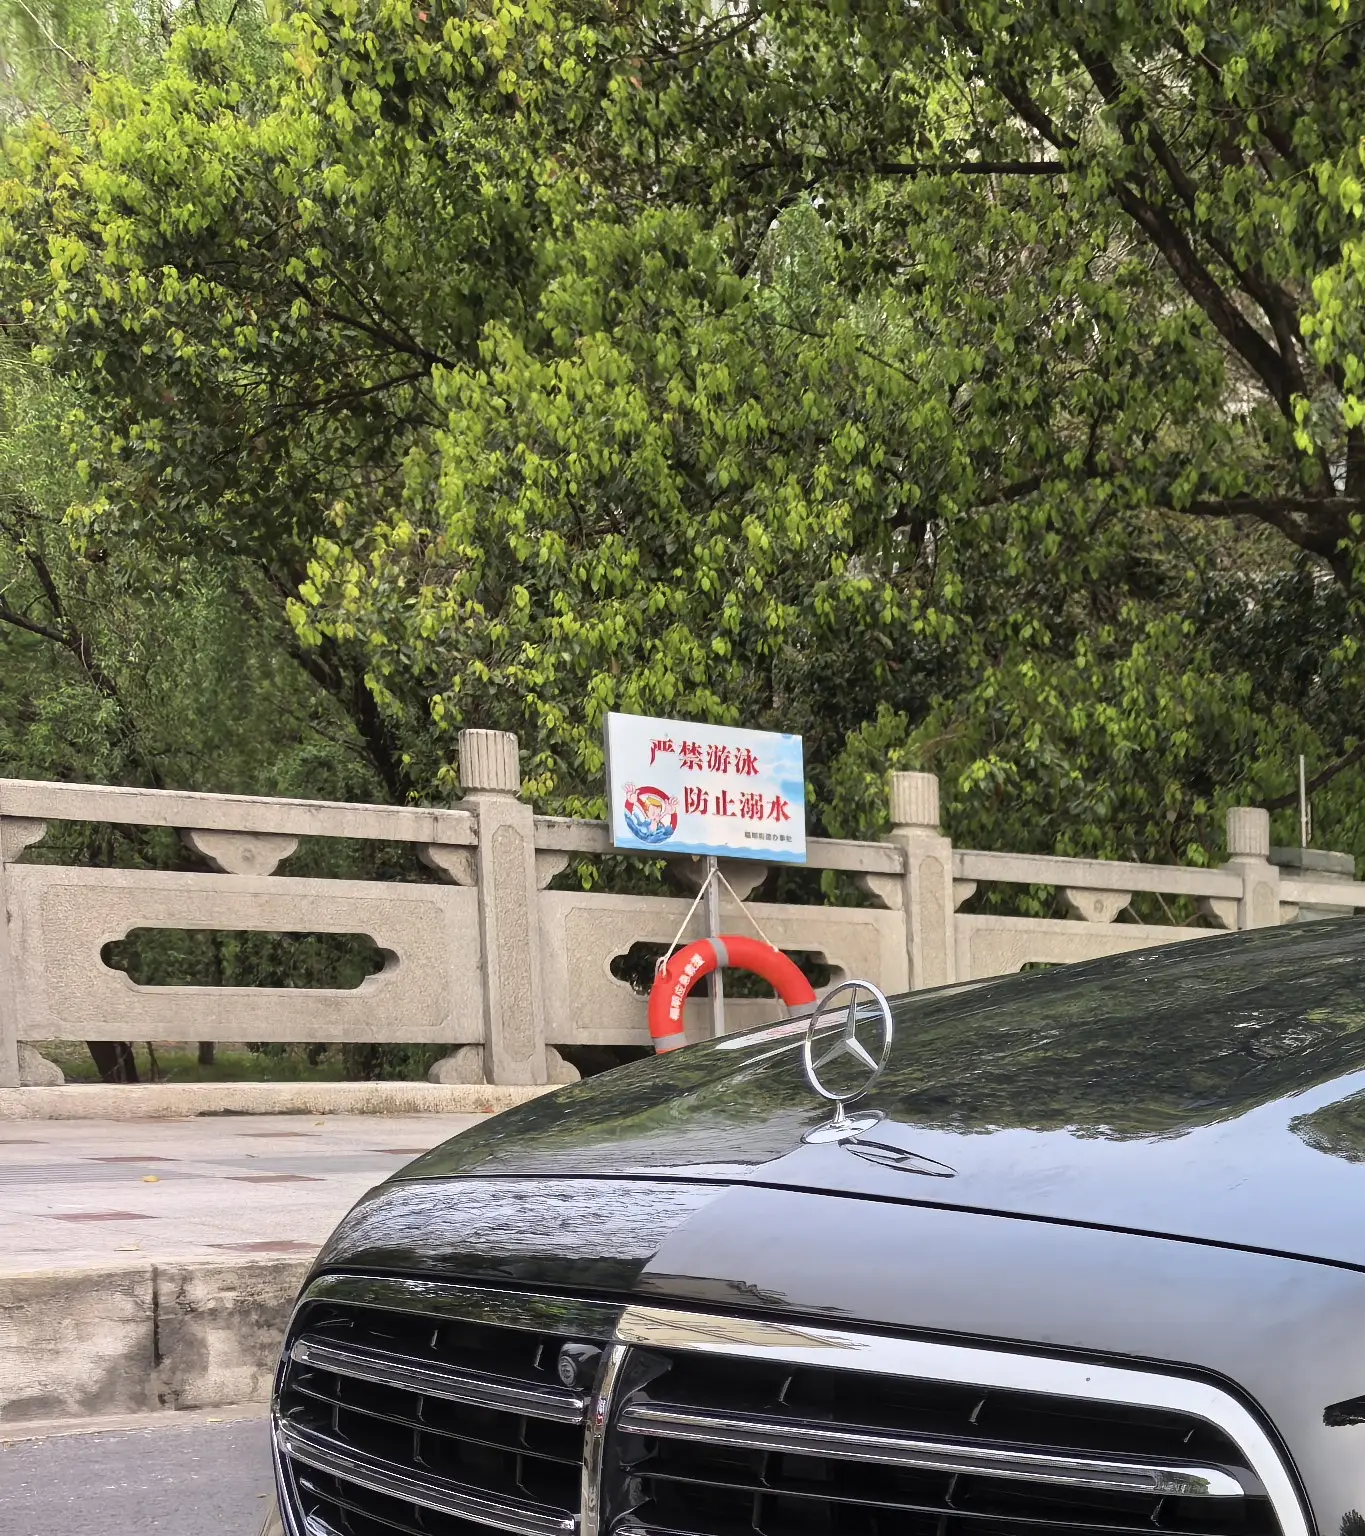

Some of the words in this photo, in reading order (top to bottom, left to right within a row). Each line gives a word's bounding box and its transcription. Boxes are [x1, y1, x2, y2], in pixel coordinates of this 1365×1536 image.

[649, 738, 760, 776] 严禁游泳
[683, 785, 791, 823] 防止溺水
